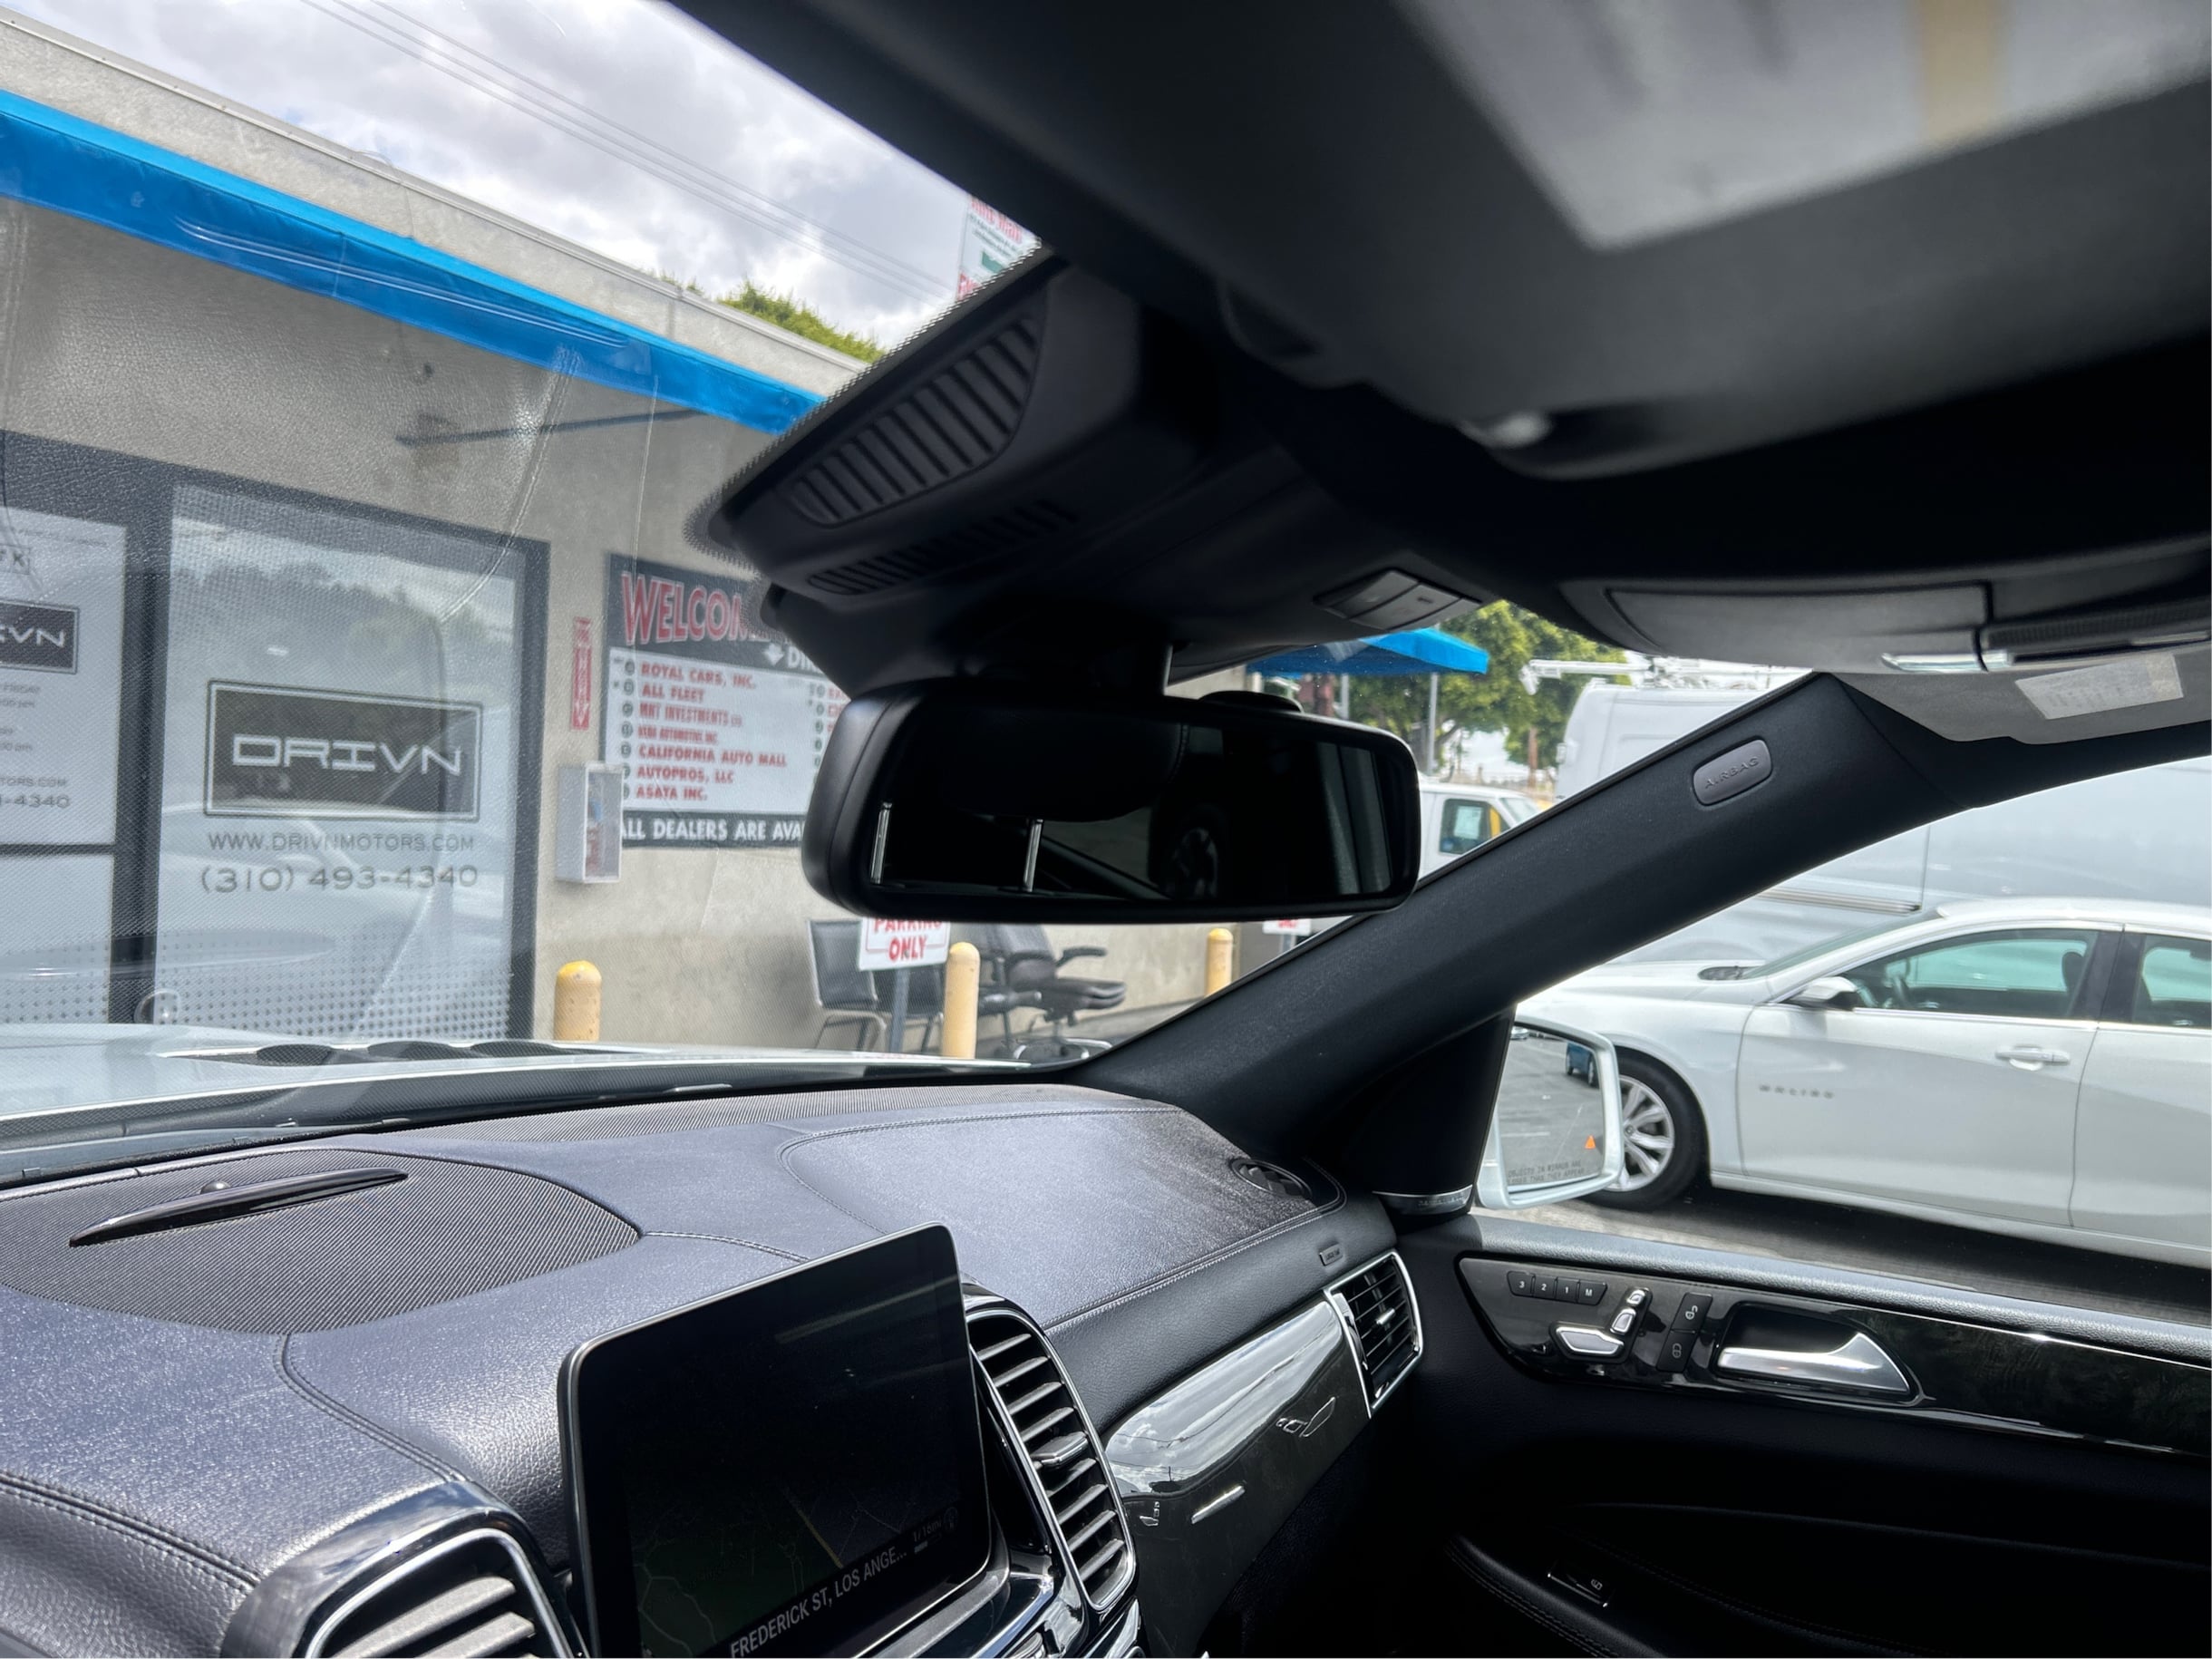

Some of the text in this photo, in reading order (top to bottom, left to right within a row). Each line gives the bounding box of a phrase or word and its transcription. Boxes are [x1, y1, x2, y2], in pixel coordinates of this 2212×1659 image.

[622, 570, 770, 645] WELCO
[0, 625, 65, 648] VN
[641, 662, 684, 680] ROYAL
[642, 683, 665, 698] ALL
[665, 703, 729, 724] INVESTMENTS
[232, 733, 462, 776] DRIVN
[638, 743, 787, 767] CALIFORNIA AUTO MALL
[637, 765, 734, 784] AUTOPROS, LLC
[0, 794, 71, 809] -4340
[636, 785, 677, 800] ASATA
[653, 819, 727, 841] DEALERS
[733, 820, 766, 840] ARE
[209, 831, 473, 852] WWW.DRIVNMOTORS.COM
[201, 864, 478, 893] (310) 493-4340
[888, 935, 927, 962] ONLY
[1518, 1280, 1525, 1288] 3
[1541, 1283, 1547, 1291] 2
[1585, 1288, 1593, 1296] M
[731, 1599, 810, 1659] FREDERICK
[812, 1586, 833, 1608] ST,
[834, 1568, 860, 1598] LOS
